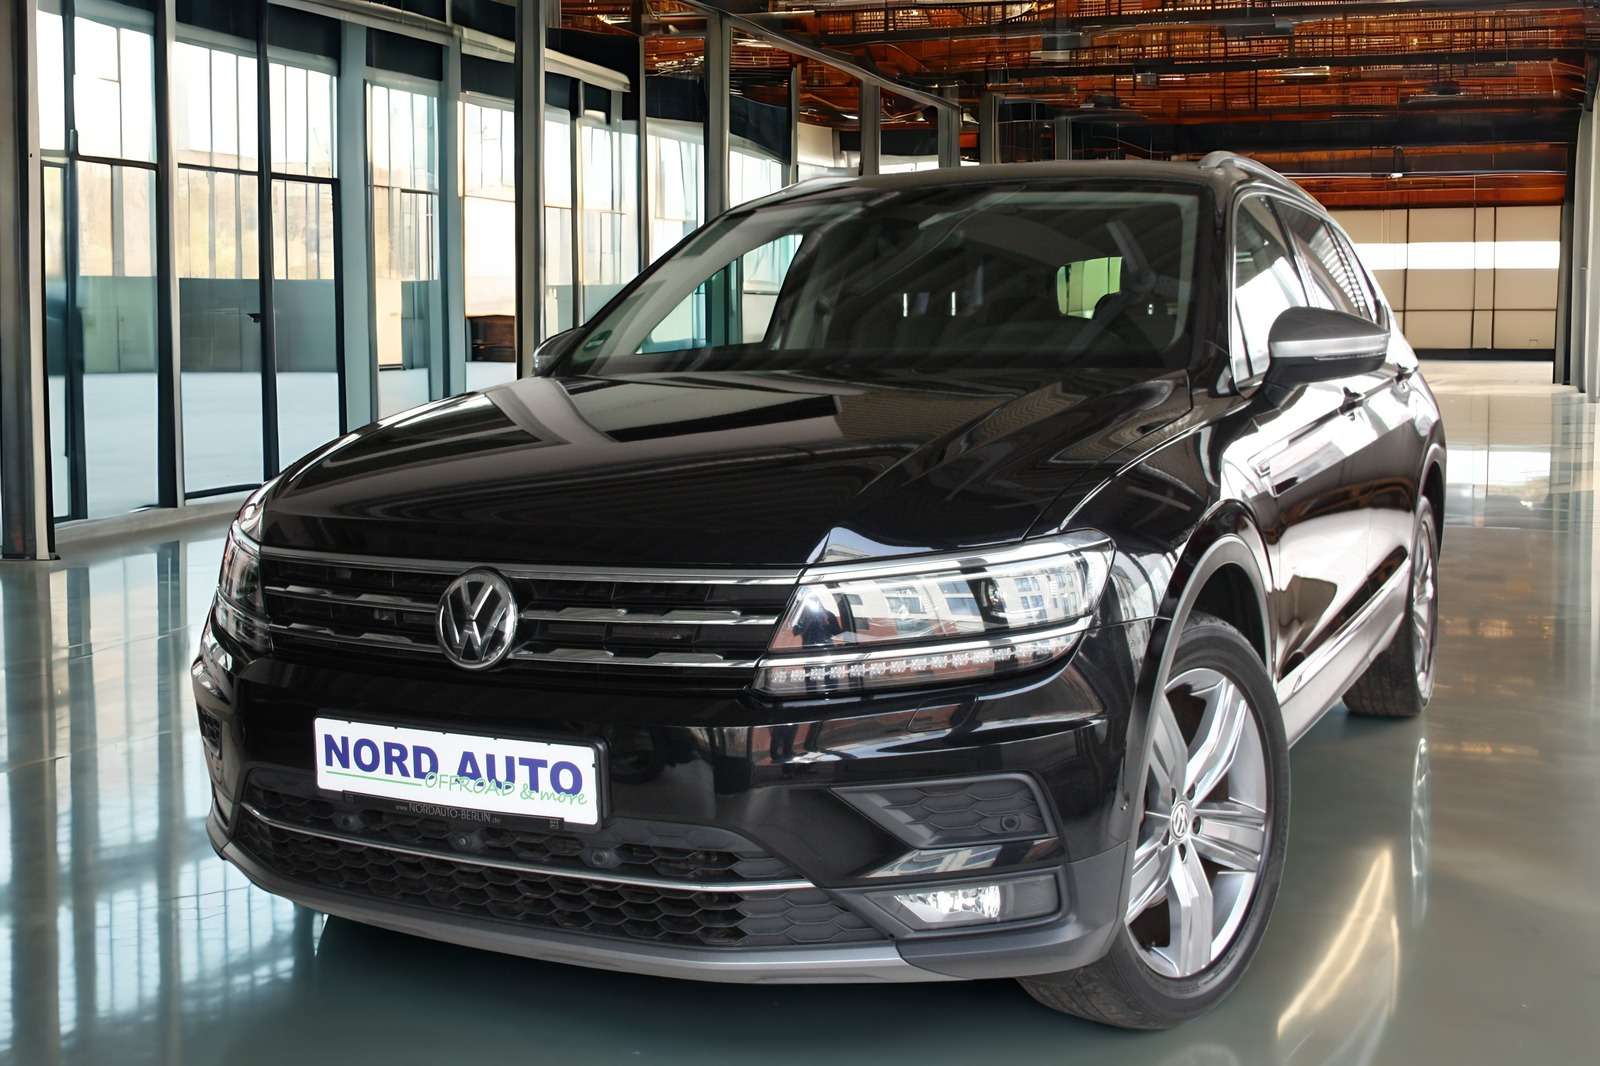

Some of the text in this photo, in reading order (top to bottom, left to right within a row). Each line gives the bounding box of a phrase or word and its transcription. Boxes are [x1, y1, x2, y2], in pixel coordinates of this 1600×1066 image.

[440, 571, 515, 667] VW
[324, 734, 583, 796] NORD AUTO
[425, 771, 588, 805] OFFROAD & more
